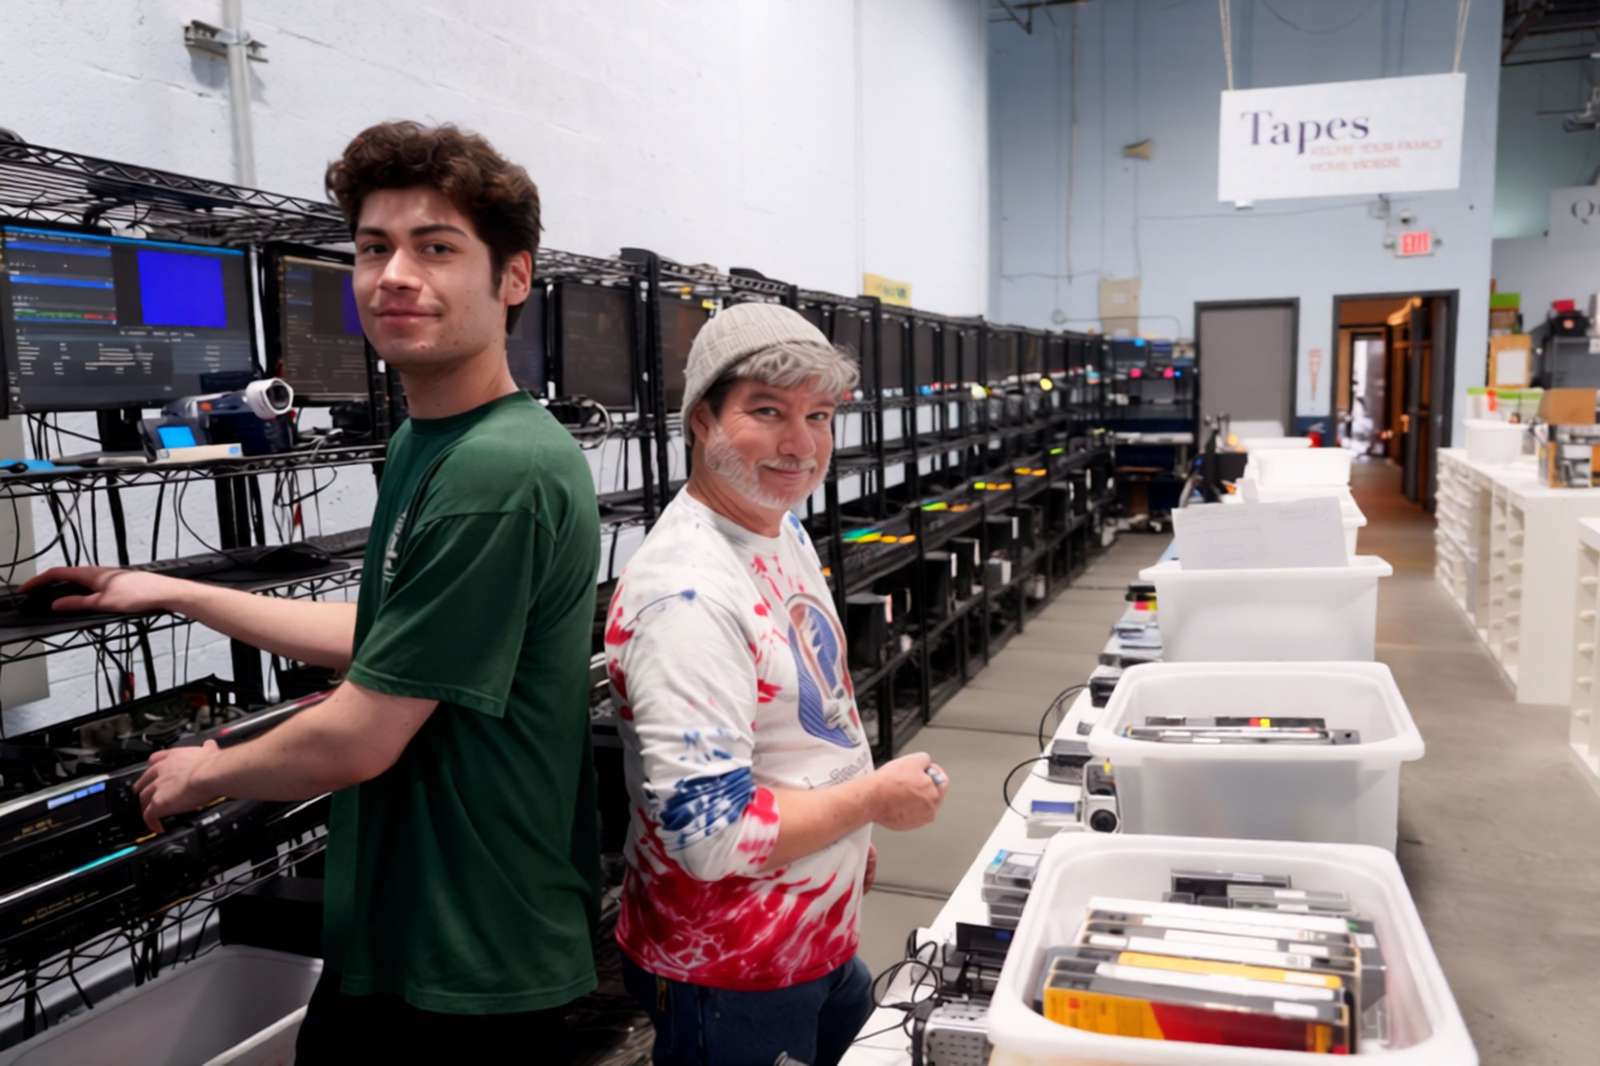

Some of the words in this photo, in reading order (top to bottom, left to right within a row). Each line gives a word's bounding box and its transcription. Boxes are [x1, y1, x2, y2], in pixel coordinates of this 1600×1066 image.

[1240, 110, 1370, 155] Tapes
[1571, 198, 1600, 225] Q
[1402, 232, 1429, 254] EXIT
